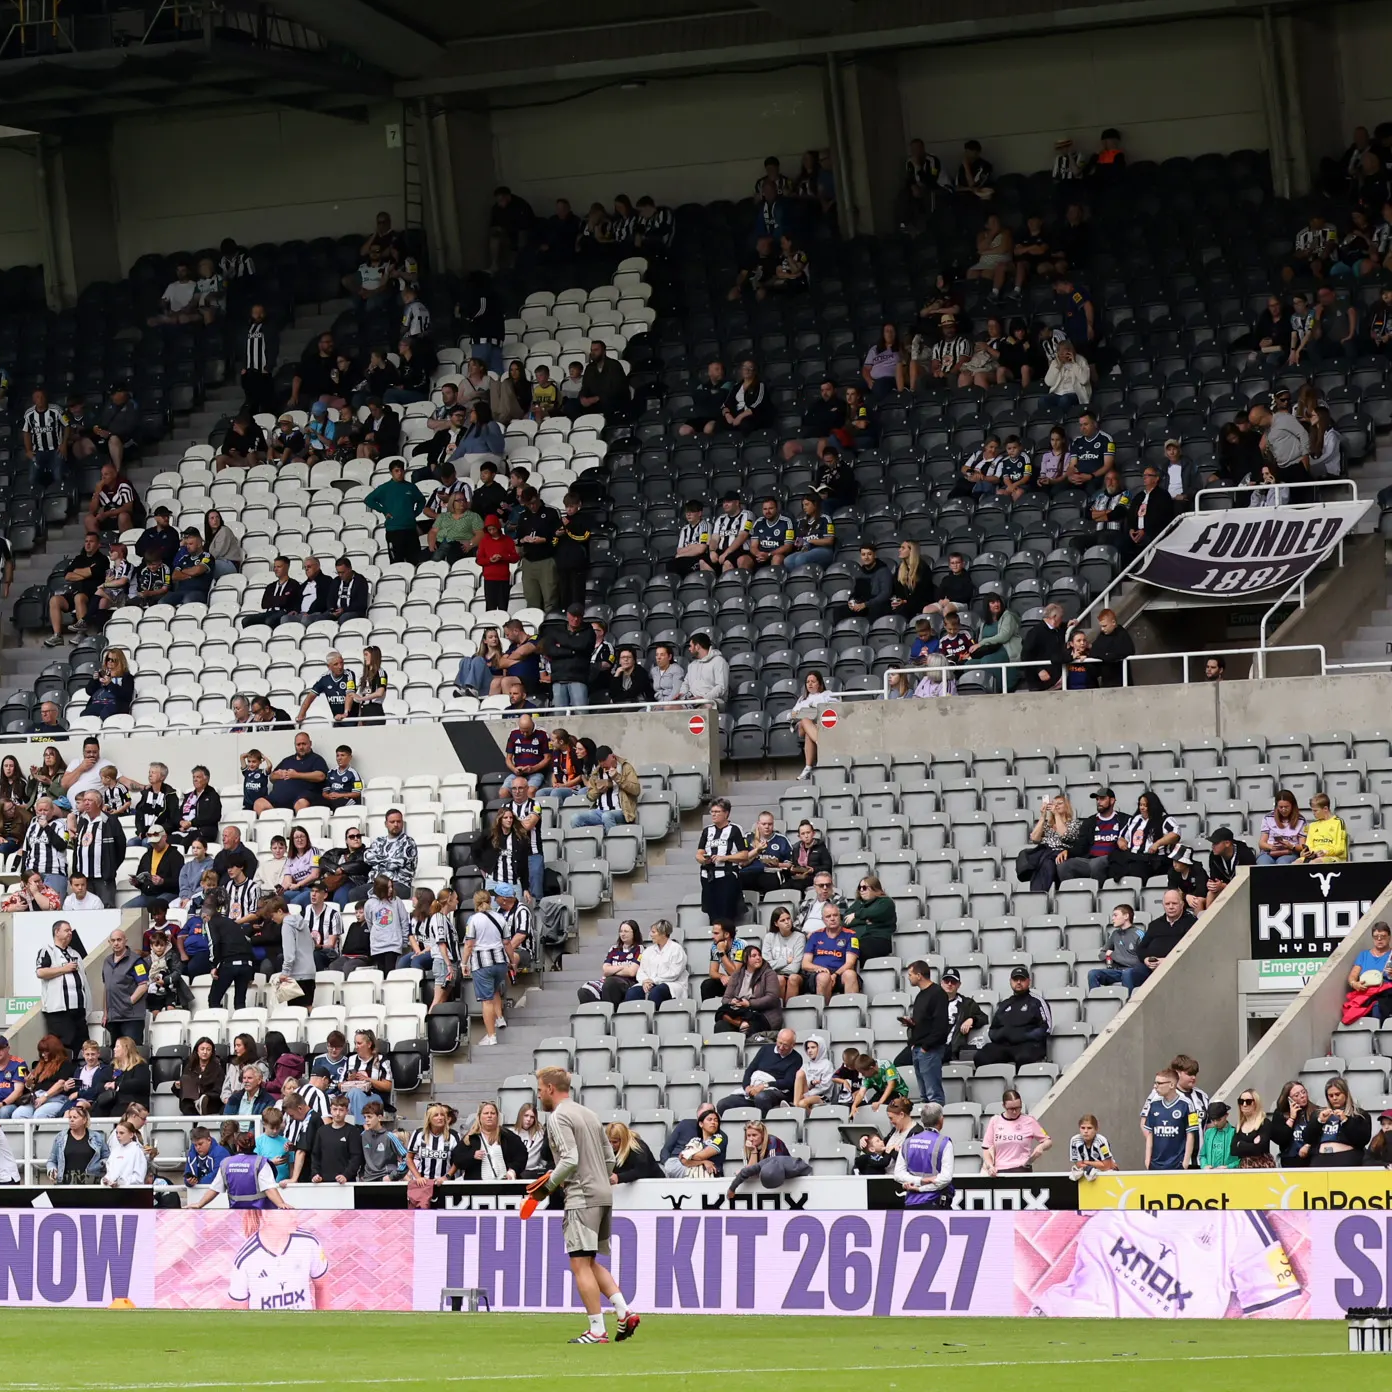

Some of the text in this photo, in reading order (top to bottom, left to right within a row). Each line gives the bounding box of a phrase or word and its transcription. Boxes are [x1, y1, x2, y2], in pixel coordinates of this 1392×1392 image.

[390, 130, 397, 140] 7
[1188, 517, 1344, 558] FOUNDED
[1190, 564, 1291, 592] 1881
[1258, 900, 1373, 941] KNO
[1279, 943, 1342, 953] HYDR
[1261, 960, 1329, 975] Emergen
[1002, 1133, 1024, 1141] sela
[429, 1150, 448, 1159] sela
[1139, 1192, 1230, 1210] InPost
[654, 1215, 768, 1309] KIT
[780, 1209, 991, 1316] 26/27
[1109, 1235, 1195, 1312] KNOX
[1333, 1213, 1392, 1316] S
[261, 1289, 306, 1310] KNOX
[1114, 1265, 1170, 1313] HYDRATE
